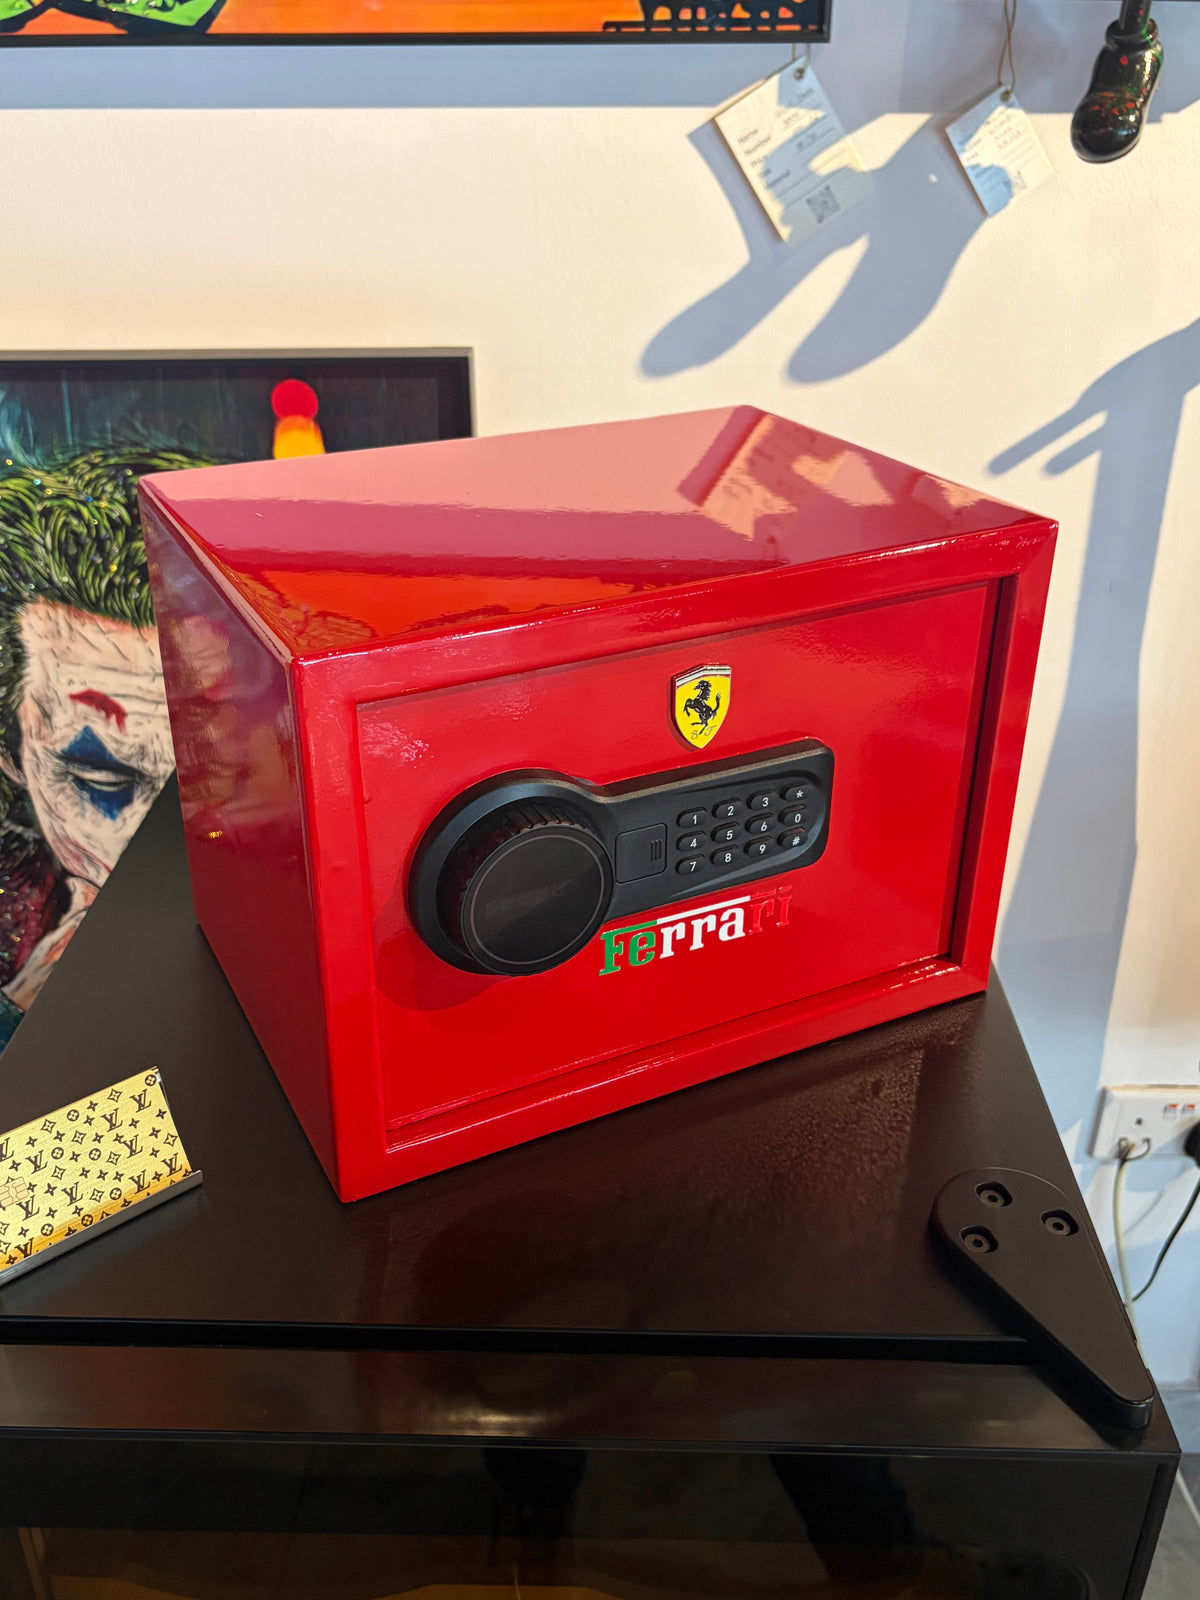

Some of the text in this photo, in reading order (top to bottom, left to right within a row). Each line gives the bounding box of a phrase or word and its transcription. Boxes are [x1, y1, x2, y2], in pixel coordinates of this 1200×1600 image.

[692, 814, 697, 825] 1
[727, 806, 734, 817] 2
[762, 797, 769, 807] 3
[690, 813, 801, 848] 4 5 6 0
[689, 861, 697, 872] 7
[725, 853, 732, 863] 8
[759, 844, 766, 855] 9
[598, 884, 792, 976] Ferrari
